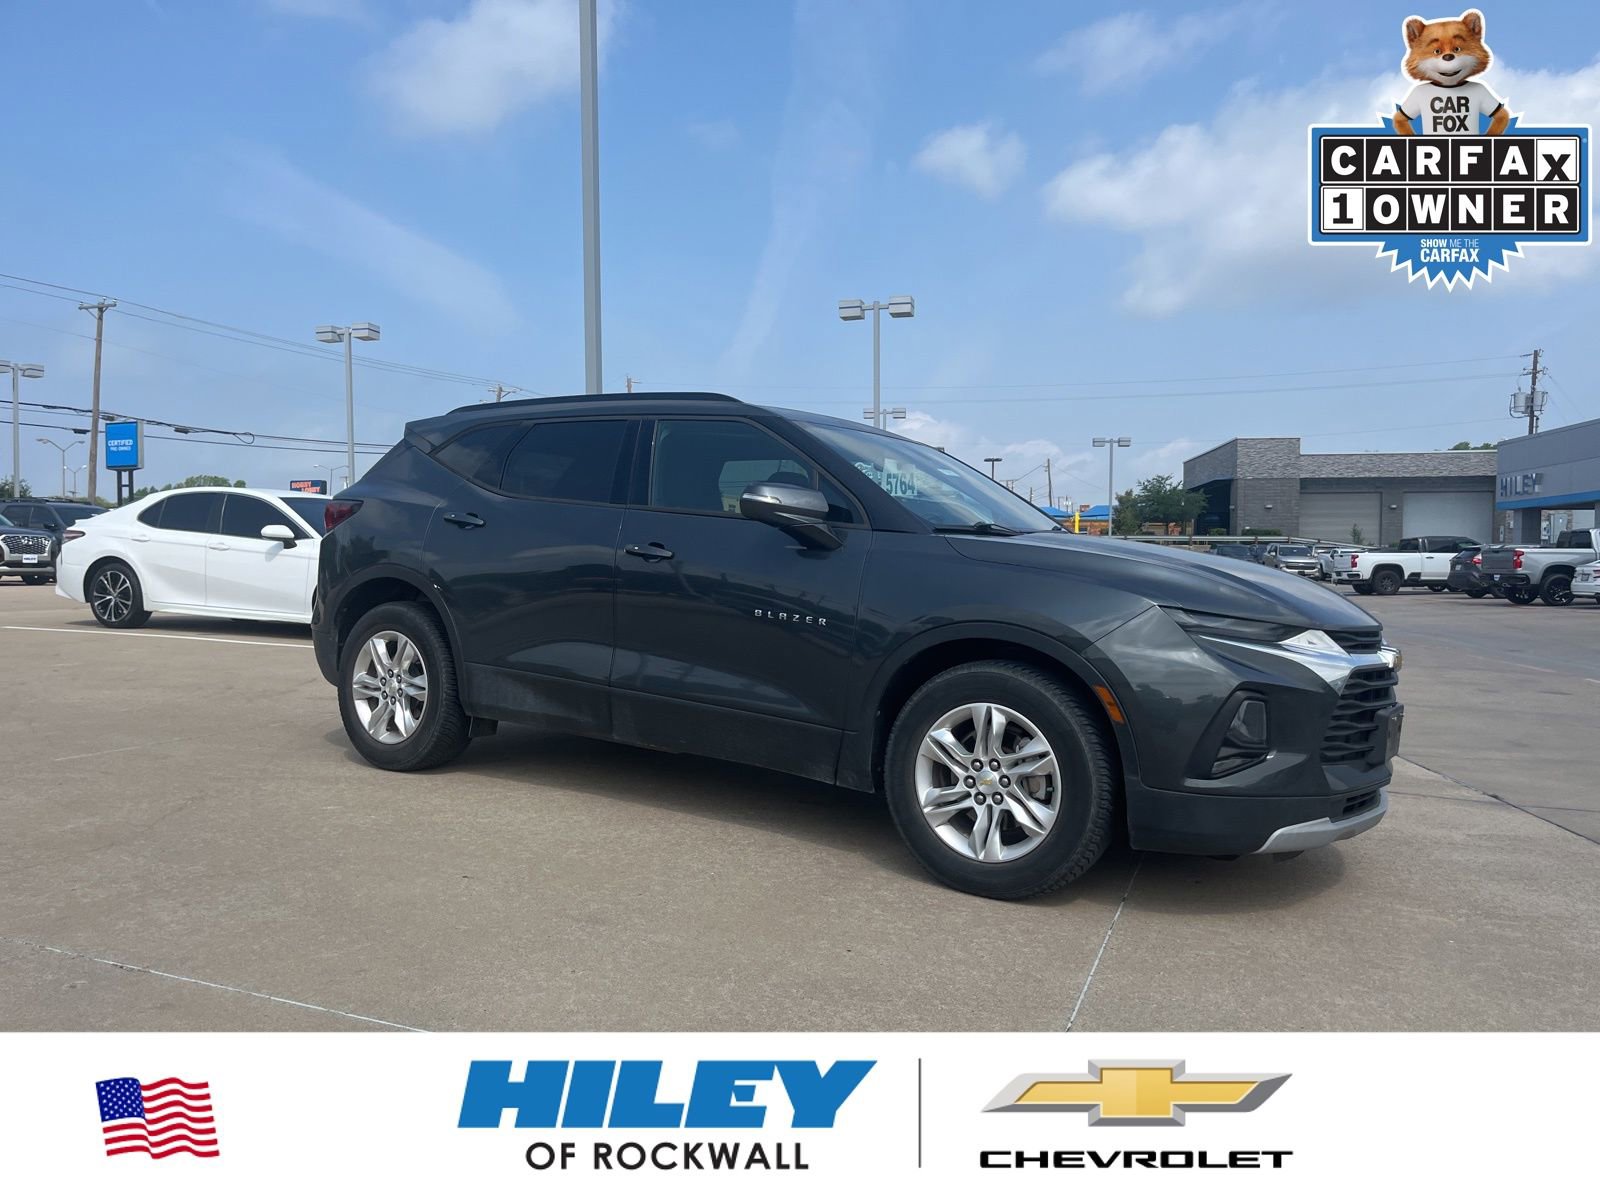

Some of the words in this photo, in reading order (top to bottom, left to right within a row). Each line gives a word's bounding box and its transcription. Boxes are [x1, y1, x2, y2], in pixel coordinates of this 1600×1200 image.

[885, 472, 917, 495] 5764
[1500, 473, 1543, 497] HILEY
[754, 609, 827, 626] BLAZER
